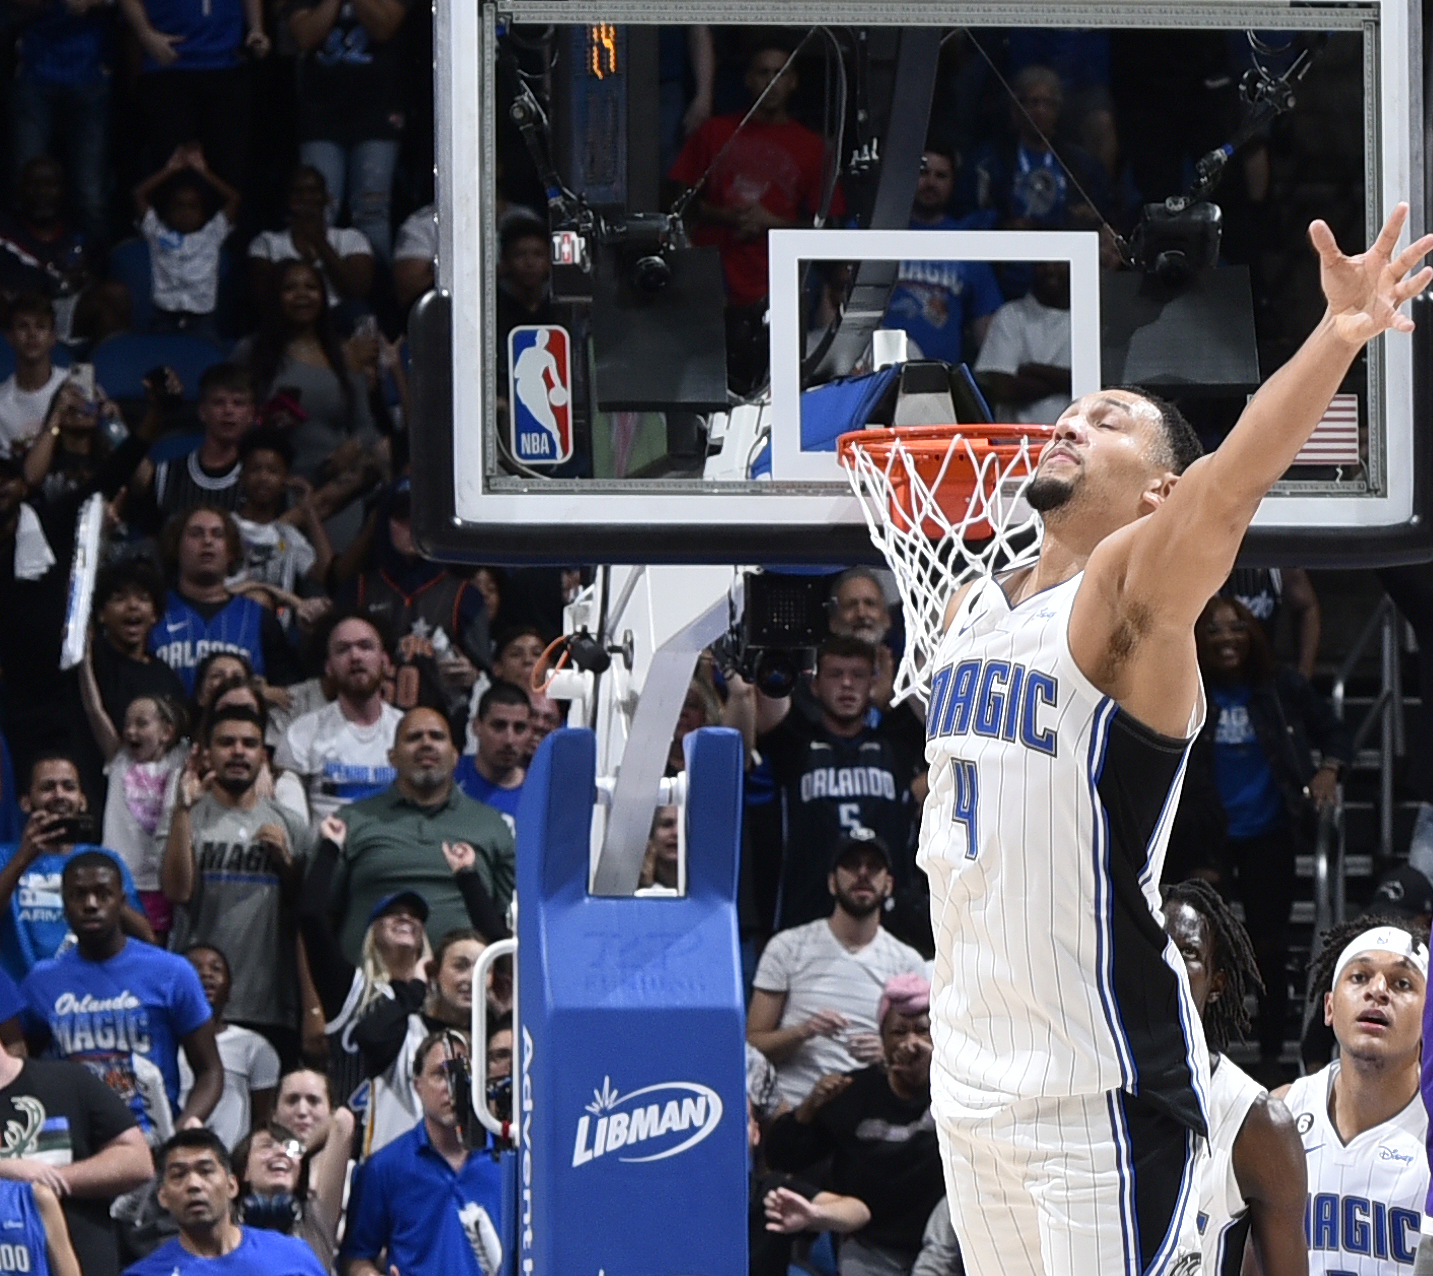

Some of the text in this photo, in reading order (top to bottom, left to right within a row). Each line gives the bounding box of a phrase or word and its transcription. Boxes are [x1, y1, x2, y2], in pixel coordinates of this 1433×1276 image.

[519, 431, 550, 456] NBA
[801, 767, 897, 802] ORLANDO
[950, 755, 978, 860] 4
[54, 989, 143, 1017] Orlando
[52, 1012, 150, 1055] MAGIC
[573, 1094, 708, 1167] LIBMAN
